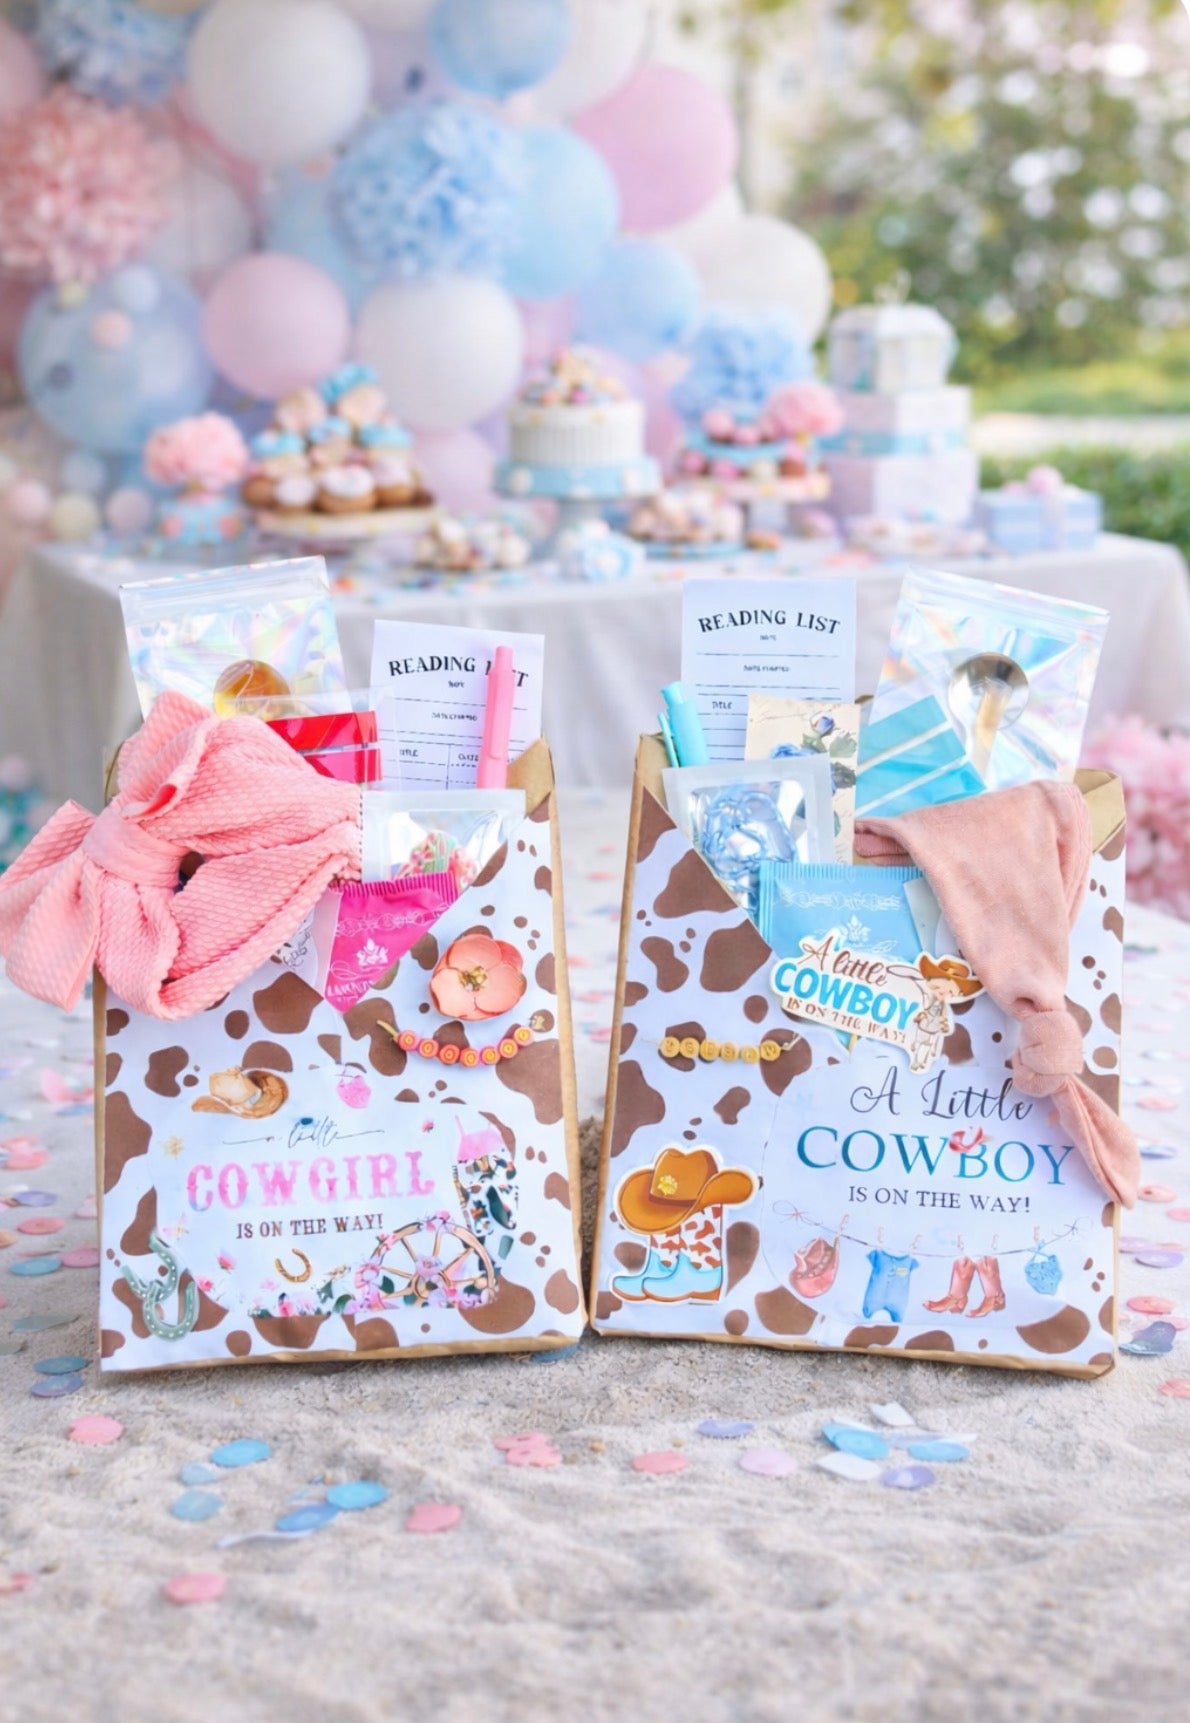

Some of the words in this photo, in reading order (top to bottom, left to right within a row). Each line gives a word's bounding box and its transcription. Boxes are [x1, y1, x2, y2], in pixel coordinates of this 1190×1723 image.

[697, 609, 787, 633] READING
[796, 612, 841, 635] LIST
[388, 655, 476, 677] READING
[798, 935, 835, 972] A
[832, 950, 888, 987] little
[774, 962, 919, 1031] COWBOY
[850, 1066, 901, 1116] A
[921, 1069, 1034, 1122] Little
[186, 1150, 436, 1213] COWGIRL
[796, 1125, 1076, 1186] COWBOY
[849, 1186, 868, 1202] IS
[875, 1187, 910, 1205] ON
[915, 1190, 961, 1209] THE
[969, 1194, 1031, 1213] WAY!
[235, 1222, 253, 1239] IS
[259, 1220, 283, 1238] ON
[290, 1218, 327, 1236] THE
[333, 1213, 384, 1234] WAY!
